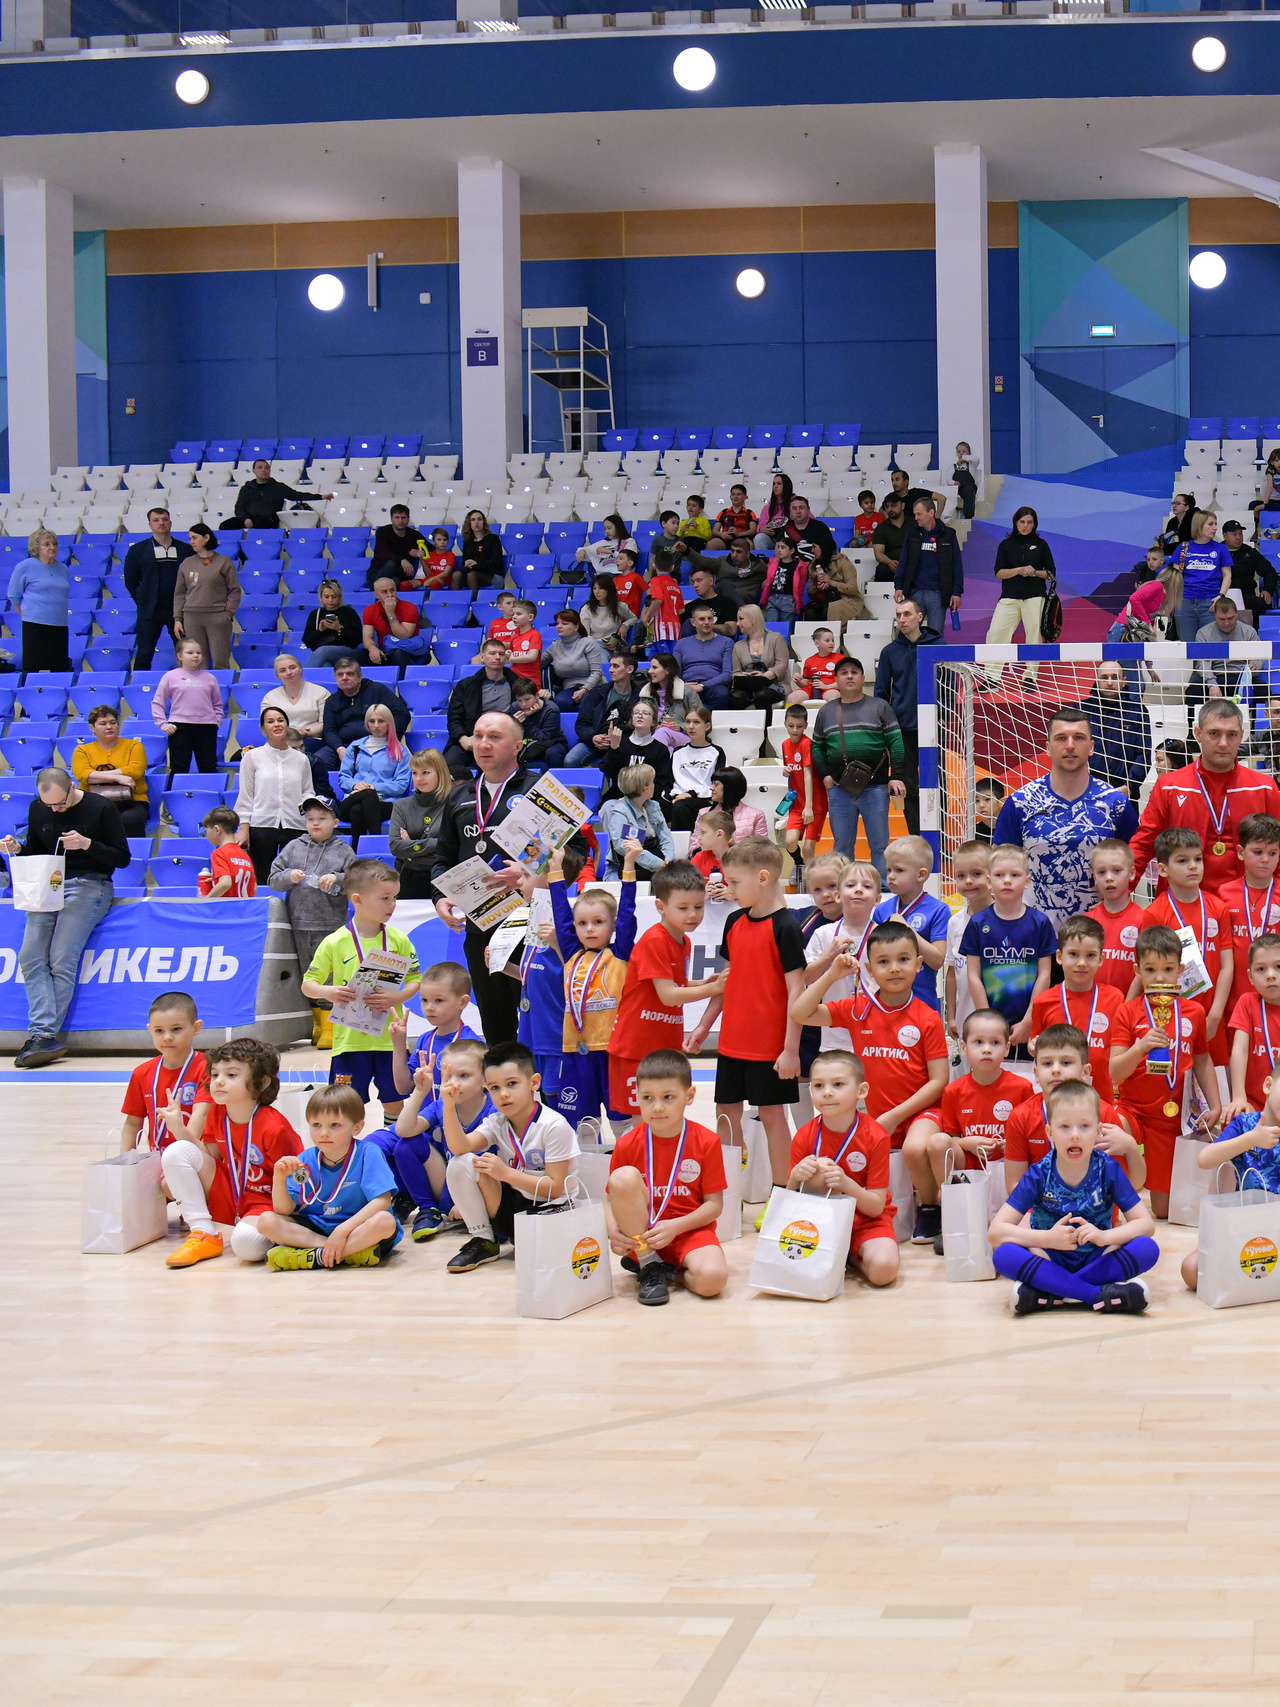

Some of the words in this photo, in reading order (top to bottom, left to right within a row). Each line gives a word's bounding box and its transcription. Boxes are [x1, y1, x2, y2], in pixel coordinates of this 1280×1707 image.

[673, 596, 680, 615] 7
[541, 777, 586, 820] ГРАМОТА
[478, 896, 524, 927] ДИПЛОМ
[983, 947, 1035, 960] OLYMP
[367, 953, 408, 971] ГРАМОТА
[862, 1046, 911, 1061] АРКТИКА
[964, 1123, 1005, 1137] АРКТИКА
[789, 1226, 818, 1239] ТУРНИР
[1245, 1245, 1275, 1257] ТУРНИР
